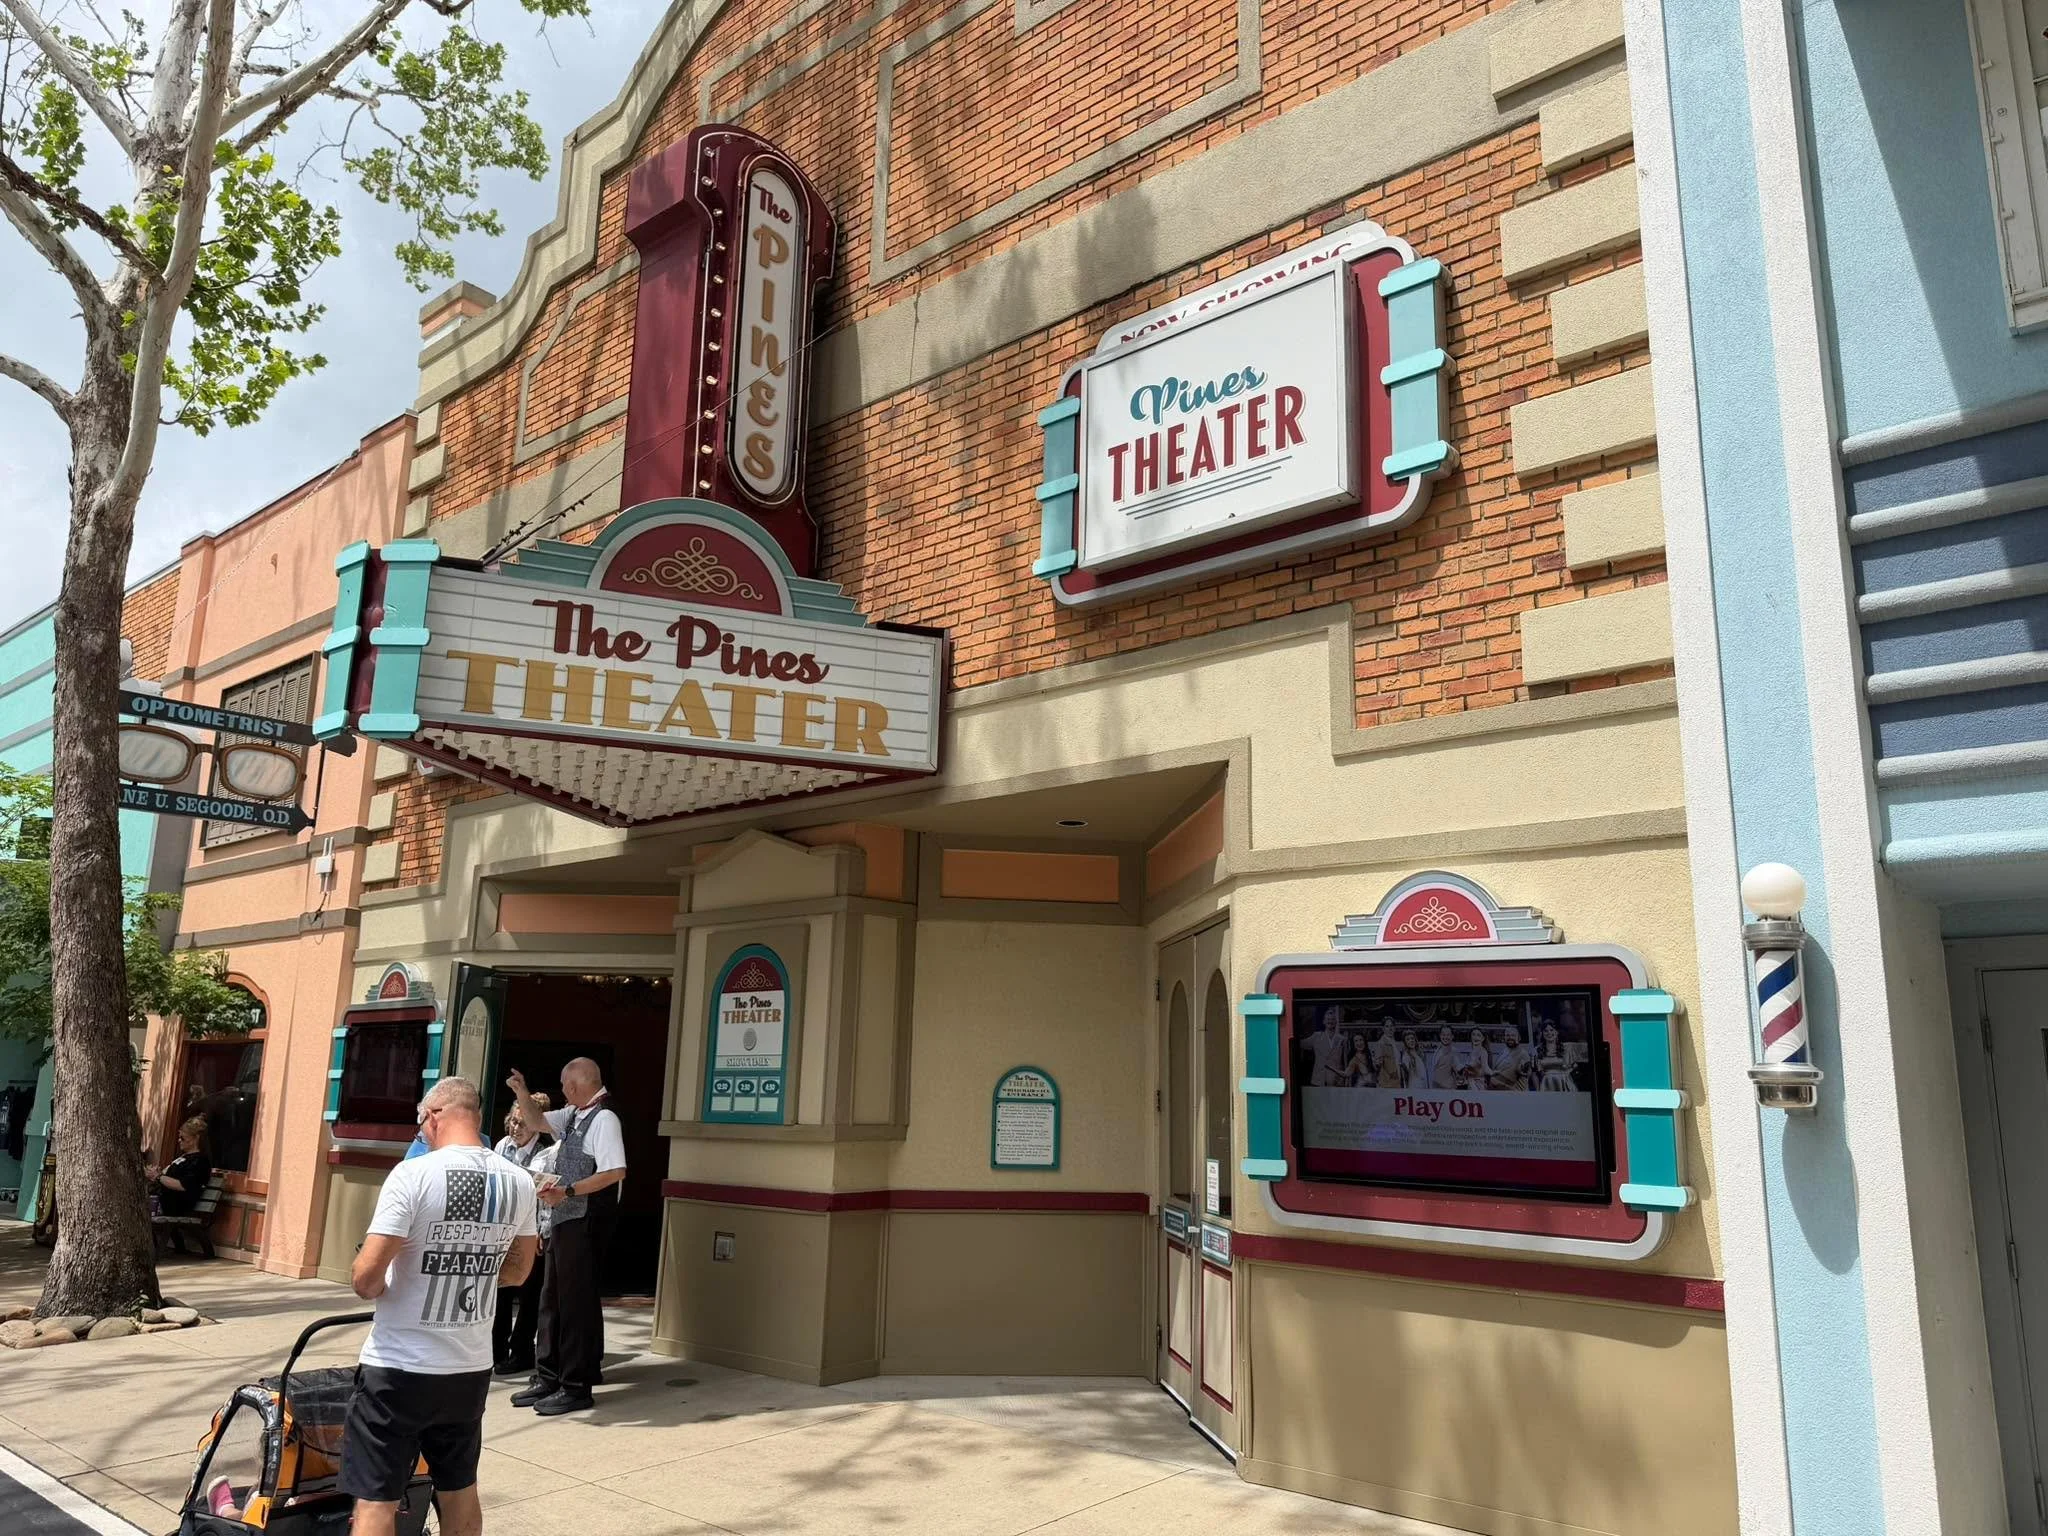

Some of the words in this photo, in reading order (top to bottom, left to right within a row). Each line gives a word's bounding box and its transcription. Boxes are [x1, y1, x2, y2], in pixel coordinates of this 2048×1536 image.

[752, 182, 793, 225] The
[1130, 365, 1268, 426] Pines
[1107, 385, 1306, 504] THEATER
[532, 599, 651, 662] The
[666, 613, 831, 684] Pines
[131, 697, 288, 737] OPTOMETRIST
[446, 649, 892, 757] THEATER
[263, 808, 291, 826] O.D.
[722, 1008, 782, 1024] THEATER
[733, 996, 748, 1009] The
[749, 995, 772, 1008] Pines
[1393, 1096, 1445, 1122] Play
[1448, 1098, 1484, 1118] On
